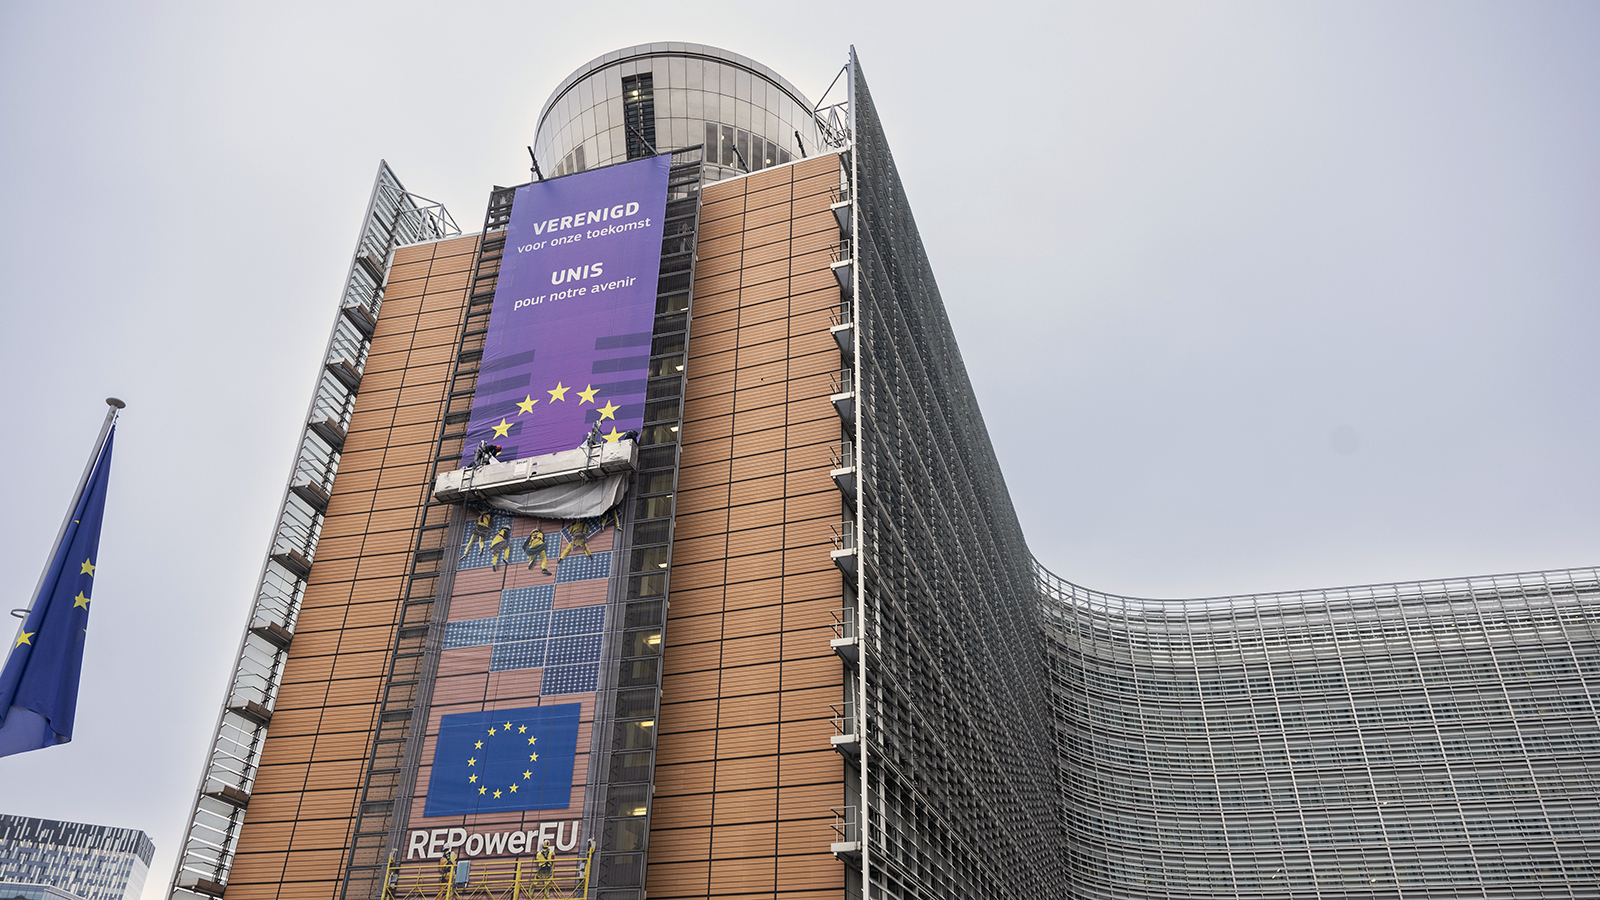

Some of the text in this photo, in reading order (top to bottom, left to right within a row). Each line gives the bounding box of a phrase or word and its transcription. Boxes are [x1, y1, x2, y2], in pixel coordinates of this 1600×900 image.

[517, 218, 651, 254] voor onze toekomst
[533, 201, 640, 236] VERENIGD
[551, 262, 604, 285] UNIS
[514, 276, 637, 311] pour notre avenir
[406, 820, 580, 860] REPowerEU
